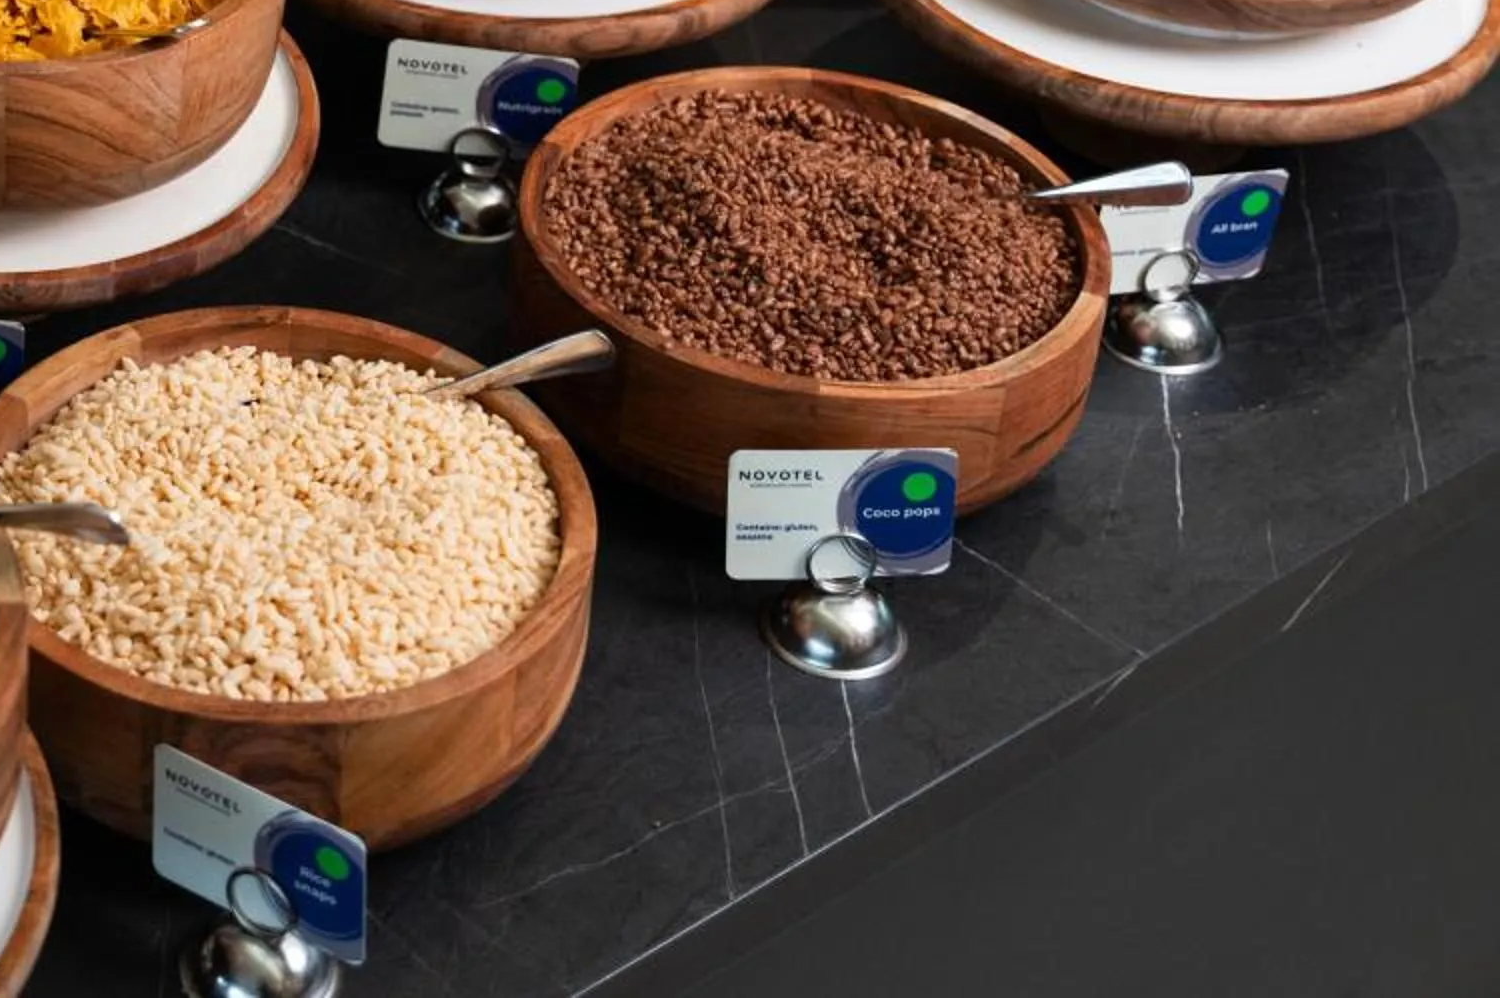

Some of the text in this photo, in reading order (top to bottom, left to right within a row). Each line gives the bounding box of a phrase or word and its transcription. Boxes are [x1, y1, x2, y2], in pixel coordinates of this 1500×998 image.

[397, 58, 468, 75] NOVOTEL
[738, 470, 824, 481] NOVOTEL
[863, 506, 941, 519] Coco pops
[165, 768, 242, 814] NOVOTEL
[299, 866, 332, 888] Rice
